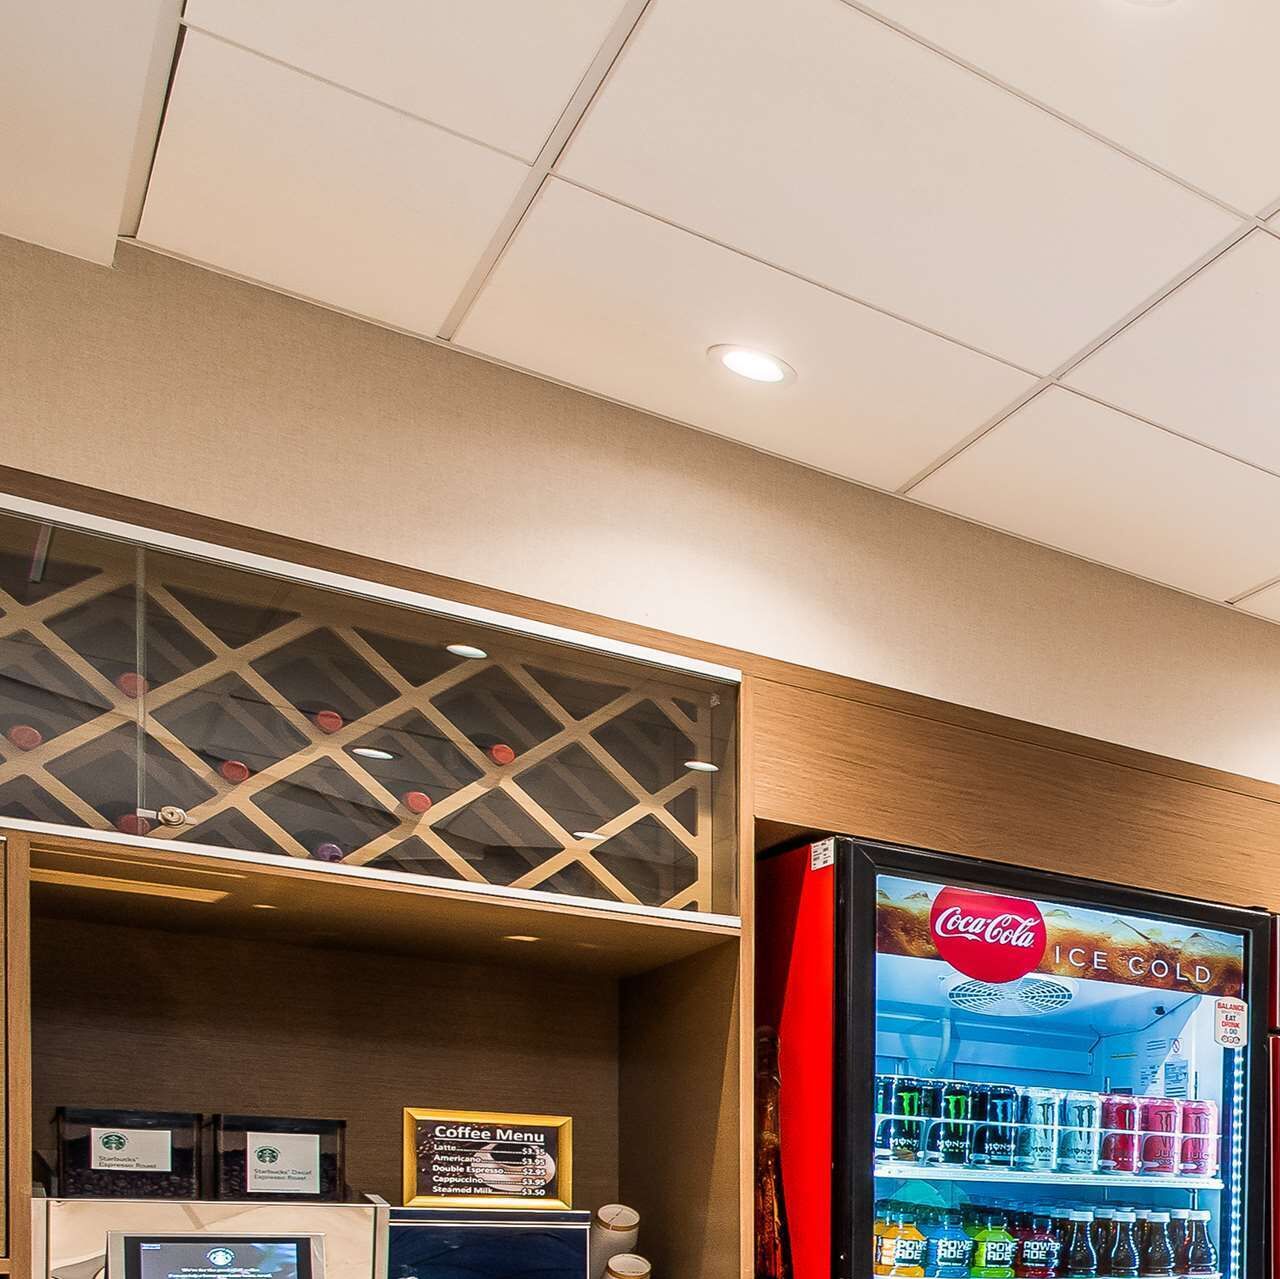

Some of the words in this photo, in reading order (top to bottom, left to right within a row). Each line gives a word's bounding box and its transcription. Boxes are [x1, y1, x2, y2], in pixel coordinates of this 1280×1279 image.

[935, 906, 1040, 948] Coca-Cola
[1055, 945, 1108, 971] ICE
[1128, 955, 1211, 984] COLD
[1217, 1002, 1244, 1011] BALANCE
[434, 1126, 491, 1140] Coffee
[496, 1129, 545, 1142] Menu
[433, 1154, 481, 1162] Americano
[466, 1167, 504, 1176] Espresso
[522, 1168, 545, 1176] $2.95
[433, 1176, 483, 1184] Cappuccino
[432, 1186, 471, 1194] Steamed
[937, 1239, 973, 1250] POWE
[895, 1250, 921, 1260] ADE
[938, 1249, 964, 1259] ADE
[987, 1250, 1011, 1261] ADE
[1022, 1250, 1046, 1260] ADE
